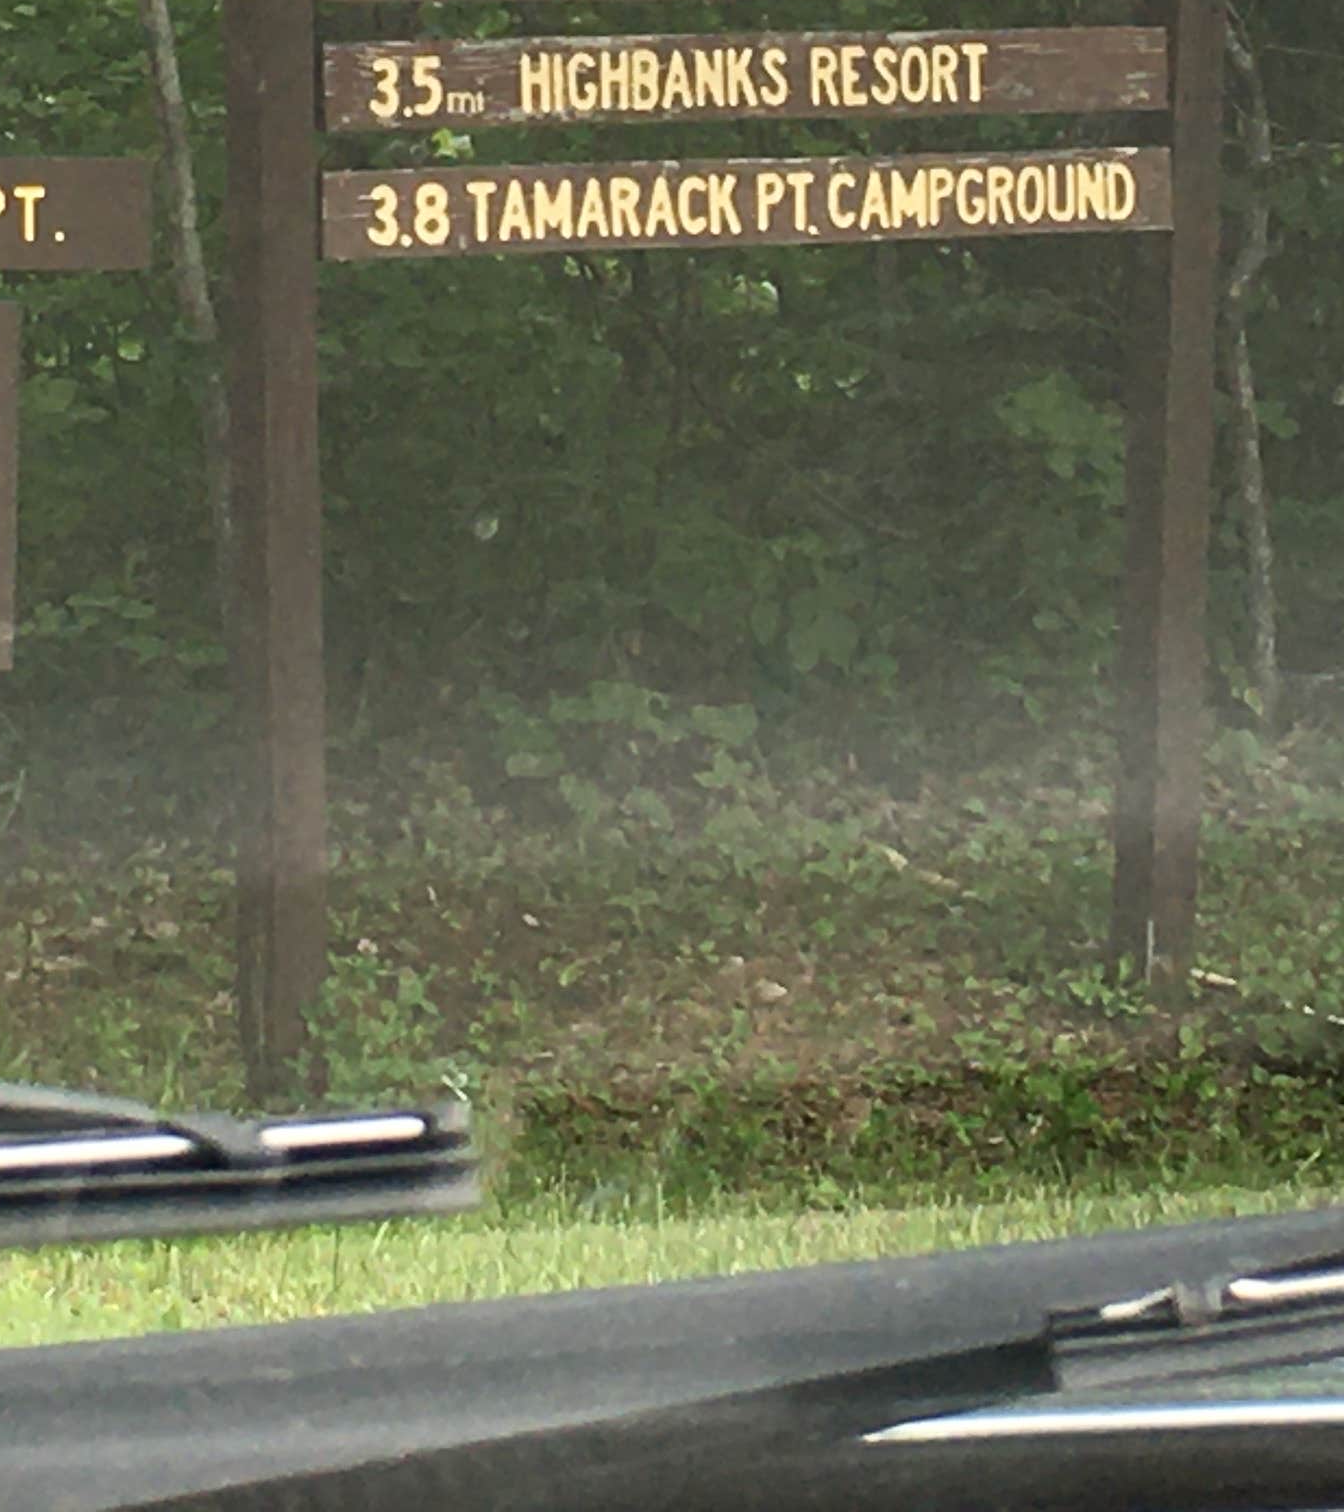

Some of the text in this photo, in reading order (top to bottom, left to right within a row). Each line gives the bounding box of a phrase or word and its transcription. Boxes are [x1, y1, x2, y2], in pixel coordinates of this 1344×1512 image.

[520, 48, 788, 113] HIGHBANKS
[809, 42, 988, 106] RESORT
[366, 160, 1136, 247] 3.8 TAMARACK PT. CAMPGROUND
